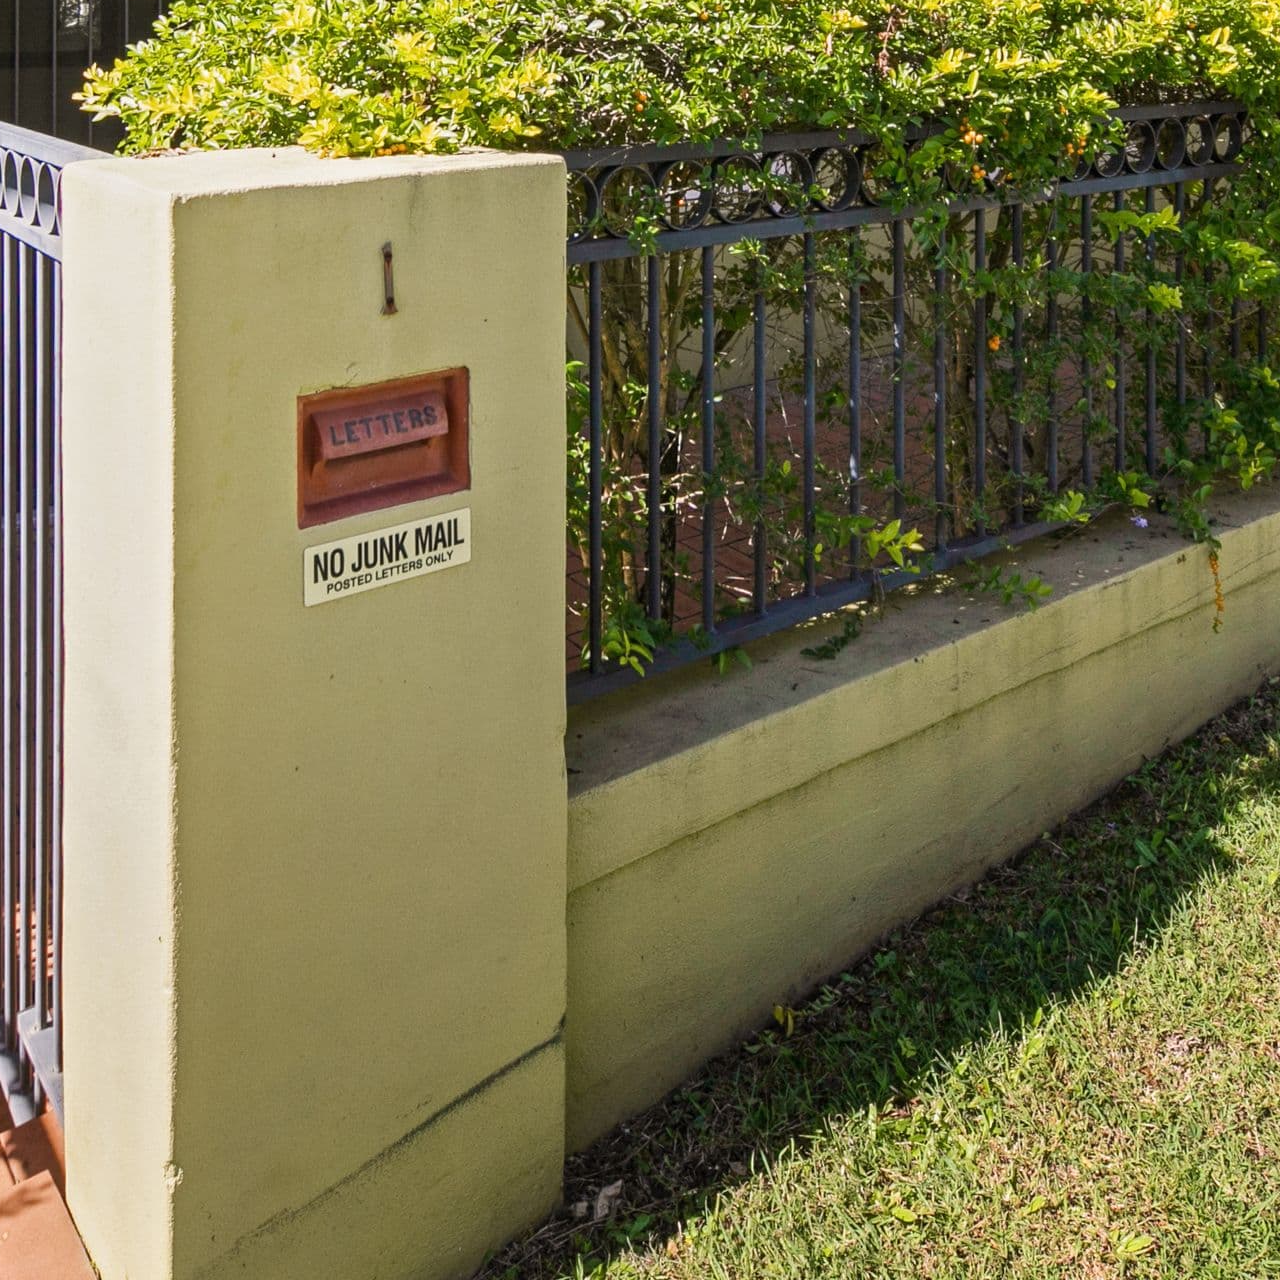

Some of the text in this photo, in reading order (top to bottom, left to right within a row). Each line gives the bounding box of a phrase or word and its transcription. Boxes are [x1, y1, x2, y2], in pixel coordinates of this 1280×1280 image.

[380, 240, 399, 316] 1
[329, 405, 437, 447] LETTERS
[313, 517, 464, 584] NO JUNK MAIL
[326, 549, 454, 594] POSTED LETTERS ONLY
